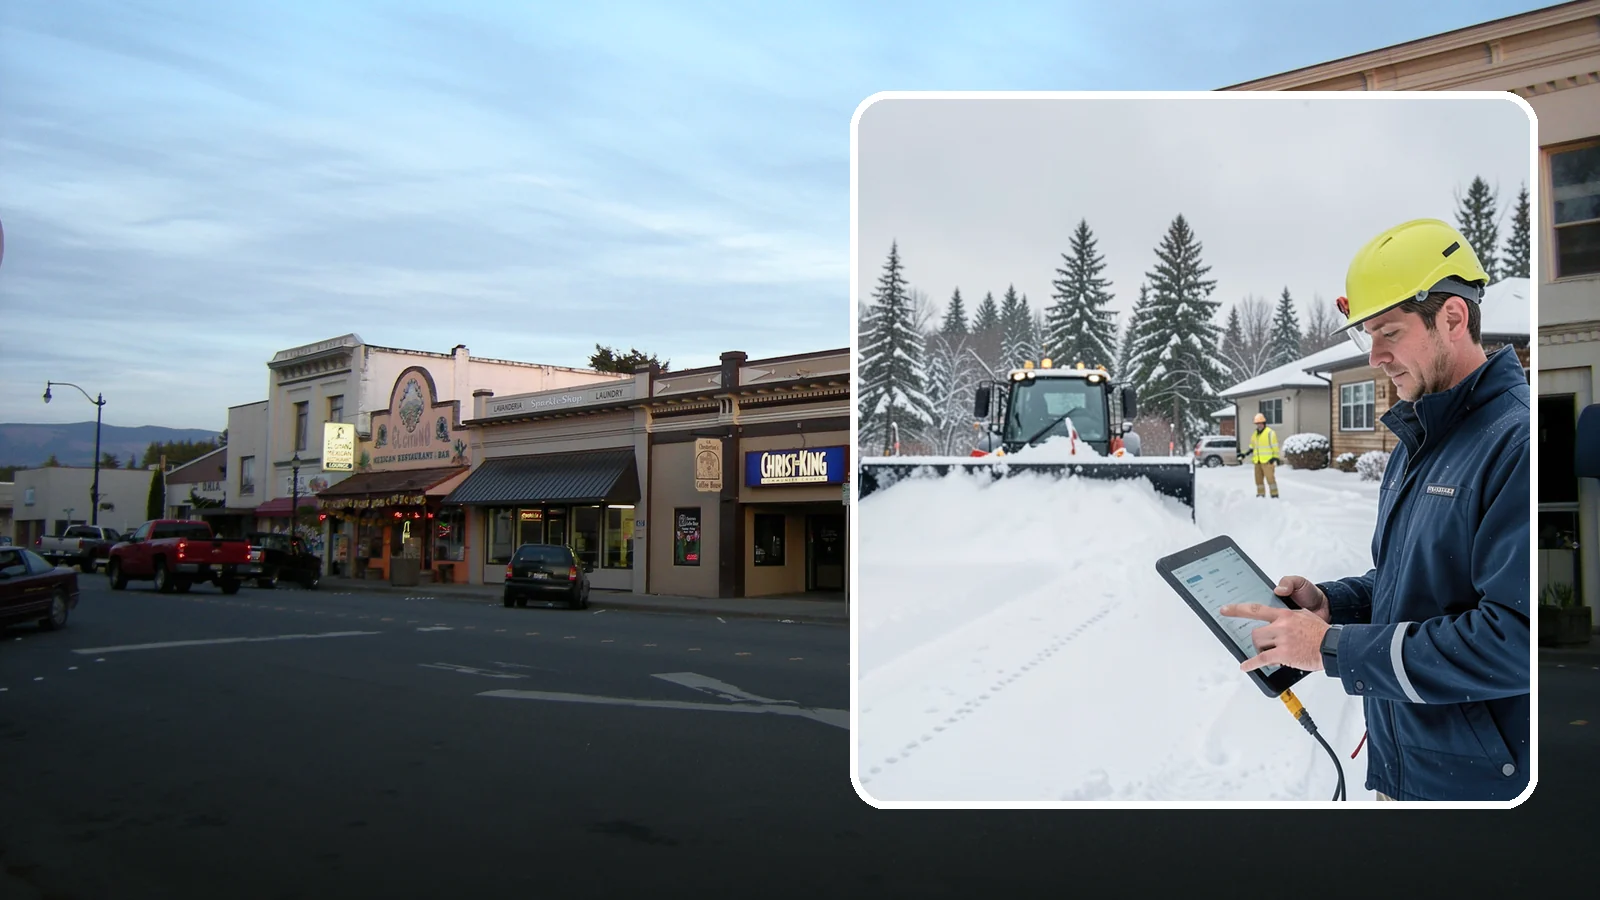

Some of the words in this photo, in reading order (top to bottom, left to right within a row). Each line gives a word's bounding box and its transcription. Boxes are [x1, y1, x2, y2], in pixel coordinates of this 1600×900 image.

[595, 389, 623, 399] LAUNDRY
[494, 402, 522, 412] LAVANDERIA
[531, 396, 560, 408] Sparkle
[562, 394, 582, 404] Shop
[373, 454, 396, 464] MEXICAN
[398, 451, 433, 462] RESTAURANT
[438, 450, 450, 458] BAR
[761, 452, 797, 478] CHRIST
[799, 450, 827, 476] KING
[697, 481, 709, 489] Coffee
[710, 481, 722, 489] House
